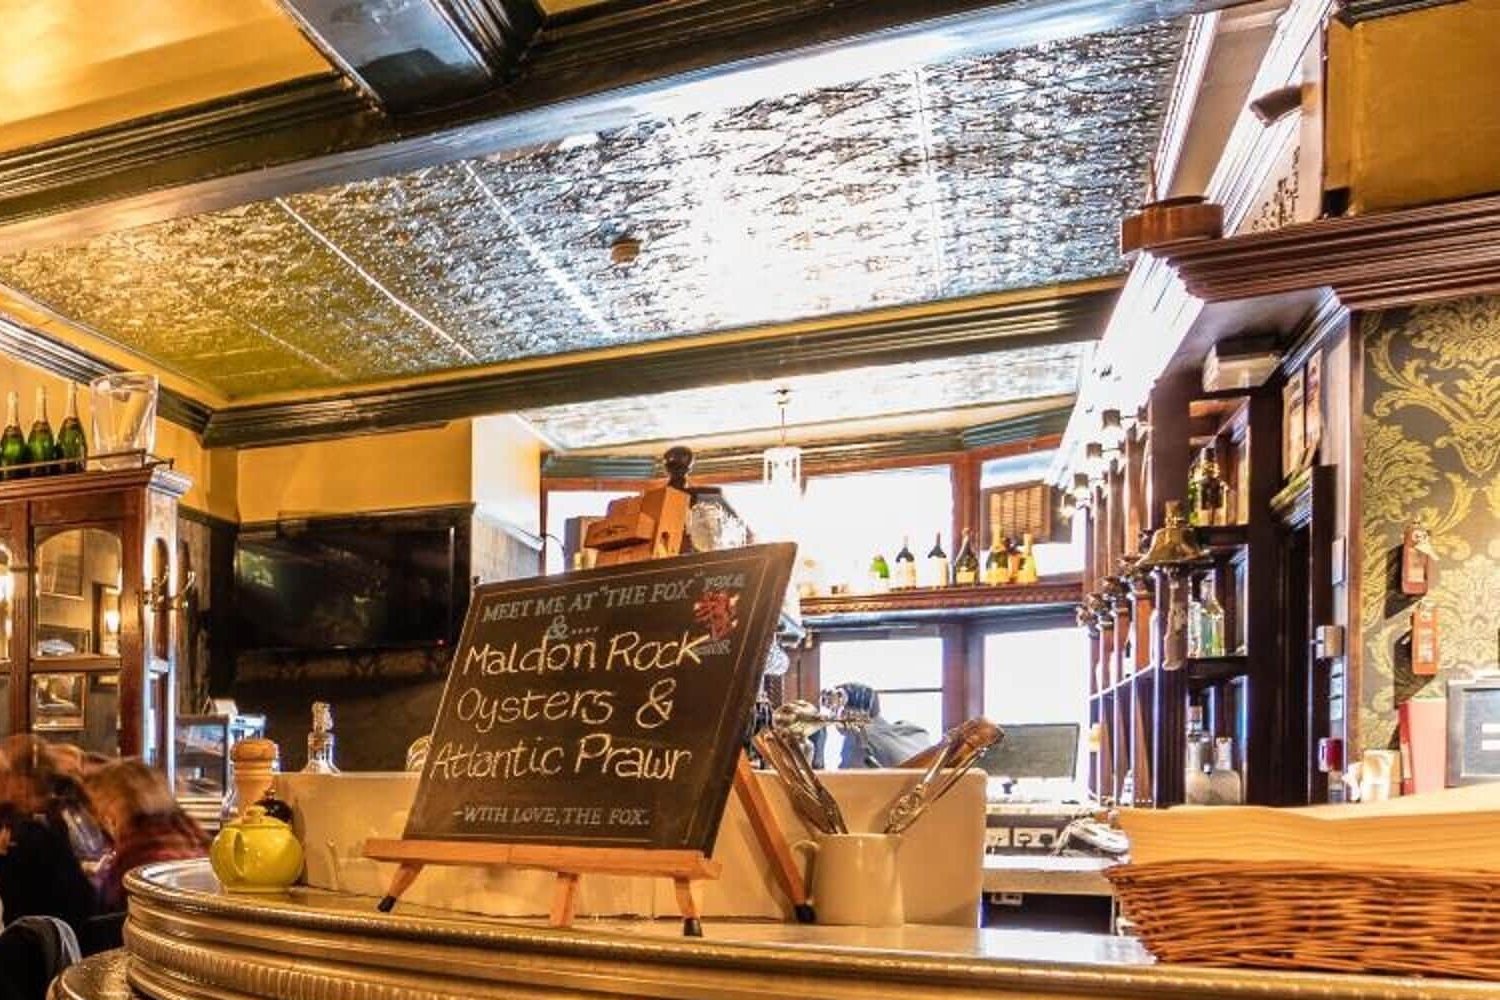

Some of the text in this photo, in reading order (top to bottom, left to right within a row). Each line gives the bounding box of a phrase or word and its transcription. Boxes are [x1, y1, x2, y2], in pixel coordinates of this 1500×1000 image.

[483, 598, 536, 622] MEET
[536, 595, 566, 616] ME
[570, 591, 599, 612] AT
[463, 630, 710, 675] Maldon Rock
[457, 677, 677, 733] Oysters &
[429, 736, 564, 780] Atlantic
